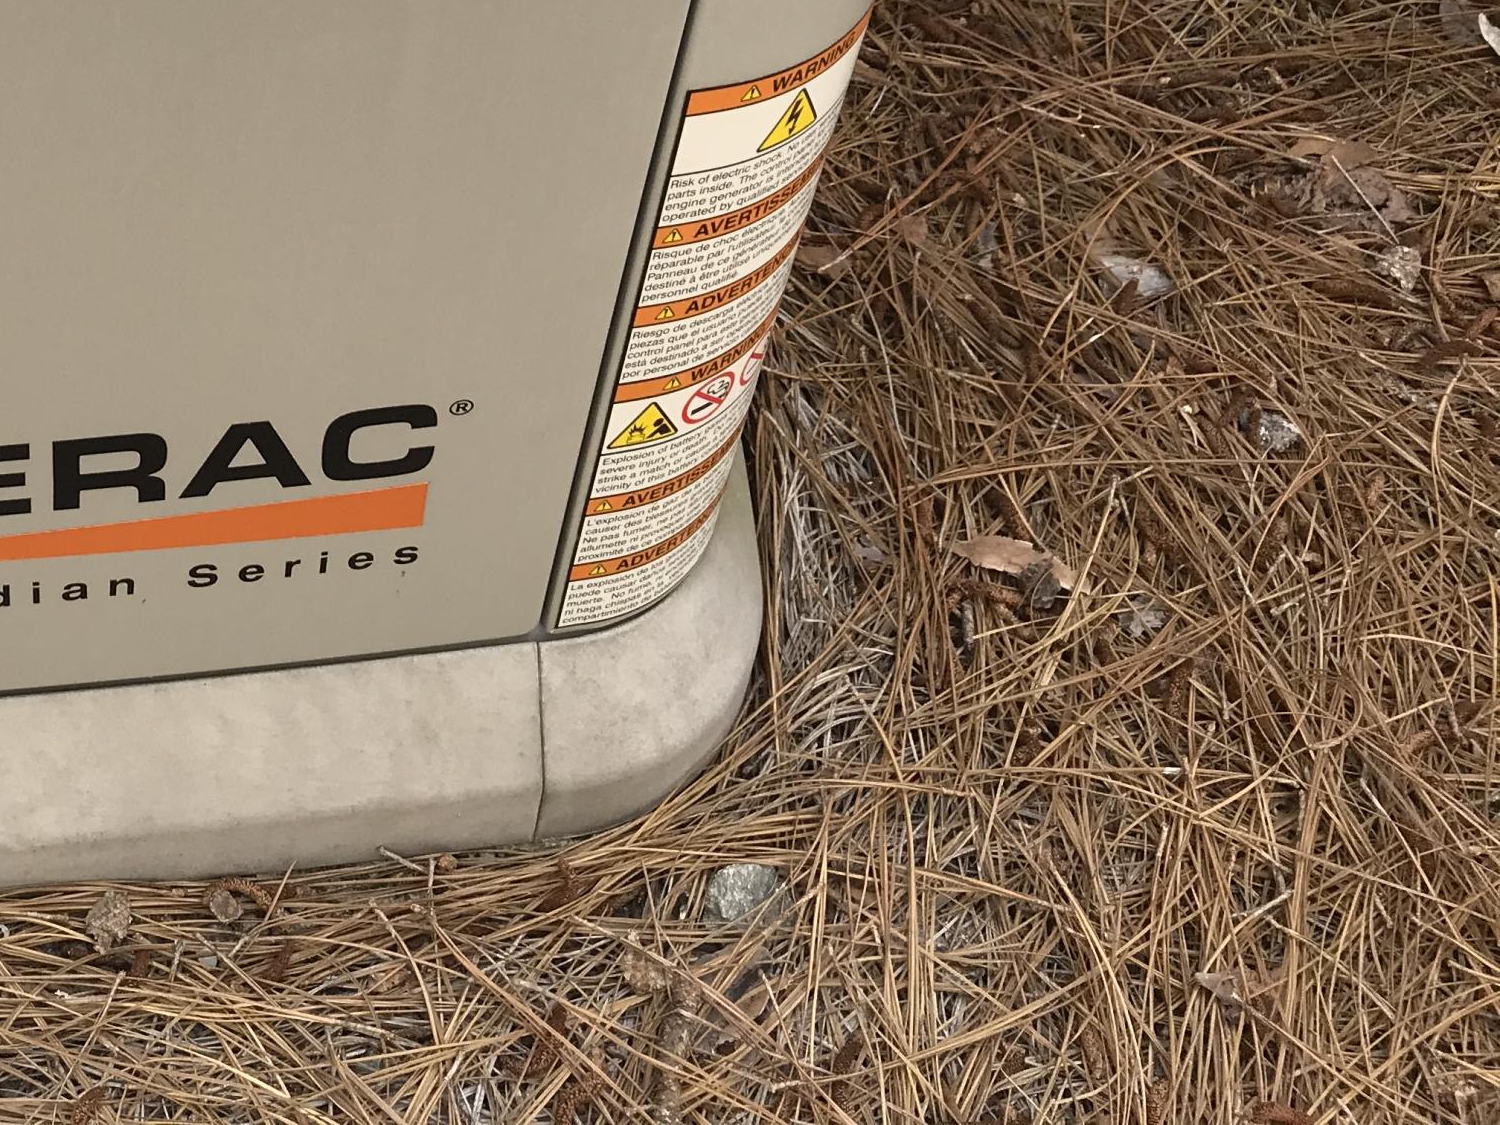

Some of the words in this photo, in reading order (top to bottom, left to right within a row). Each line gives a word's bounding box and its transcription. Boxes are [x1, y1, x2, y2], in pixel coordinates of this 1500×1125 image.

[773, 31, 856, 93] WARNING
[667, 189, 696, 201] parts
[740, 173, 758, 185] The
[670, 178, 695, 189] Risk
[698, 174, 710, 185] of
[712, 165, 751, 181] electric
[664, 198, 706, 211] engine
[709, 180, 764, 206] generator
[661, 204, 717, 223] operated
[719, 201, 734, 212] by
[652, 247, 693, 261] Risque
[696, 243, 710, 253] de
[713, 233, 740, 249] choc
[647, 267, 698, 281] Panneau
[700, 261, 714, 271] de
[717, 256, 730, 266] ce
[649, 255, 704, 271] réparable
[706, 249, 726, 262] par
[644, 277, 686, 292] destiné
[699, 268, 720, 281] être
[641, 284, 699, 304] personnel
[632, 327, 670, 339] Riesgo
[673, 323, 686, 333] de
[689, 305, 734, 328] descarga
[627, 347, 664, 359] control
[666, 339, 695, 353] panel
[696, 331, 718, 347] para
[629, 338, 665, 351] piezas
[667, 333, 689, 343] que
[690, 329, 700, 337] el
[622, 369, 642, 380] por
[643, 357, 690, 377] personal
[692, 353, 705, 363] de
[624, 358, 647, 369] está
[649, 346, 700, 365] destinado
[600, 464, 636, 475] severe
[639, 455, 668, 469] injury
[670, 451, 680, 459] or
[602, 451, 655, 466] Explosion
[658, 445, 668, 455] of
[598, 473, 627, 484] strike
[640, 463, 671, 477] match
[674, 457, 684, 465] or
[596, 481, 632, 493] vicinity
[634, 477, 645, 487] of
[648, 505, 660, 514] de
[585, 525, 621, 535] causer
[624, 517, 642, 529] des
[579, 539, 627, 553] allumette
[629, 535, 639, 543] ni
[582, 536, 598, 545] Ne
[600, 533, 620, 543] pas
[577, 547, 625, 563] proximité
[626, 543, 640, 553] de
[186, 542, 421, 590] Series
[570, 583, 584, 591] La
[636, 566, 650, 576] de
[568, 589, 602, 601] puede
[604, 579, 638, 594] causar
[610, 591, 626, 599] No
[562, 601, 640, 623] compartimiento
[564, 607, 574, 615] ni
[576, 603, 602, 615] haga
